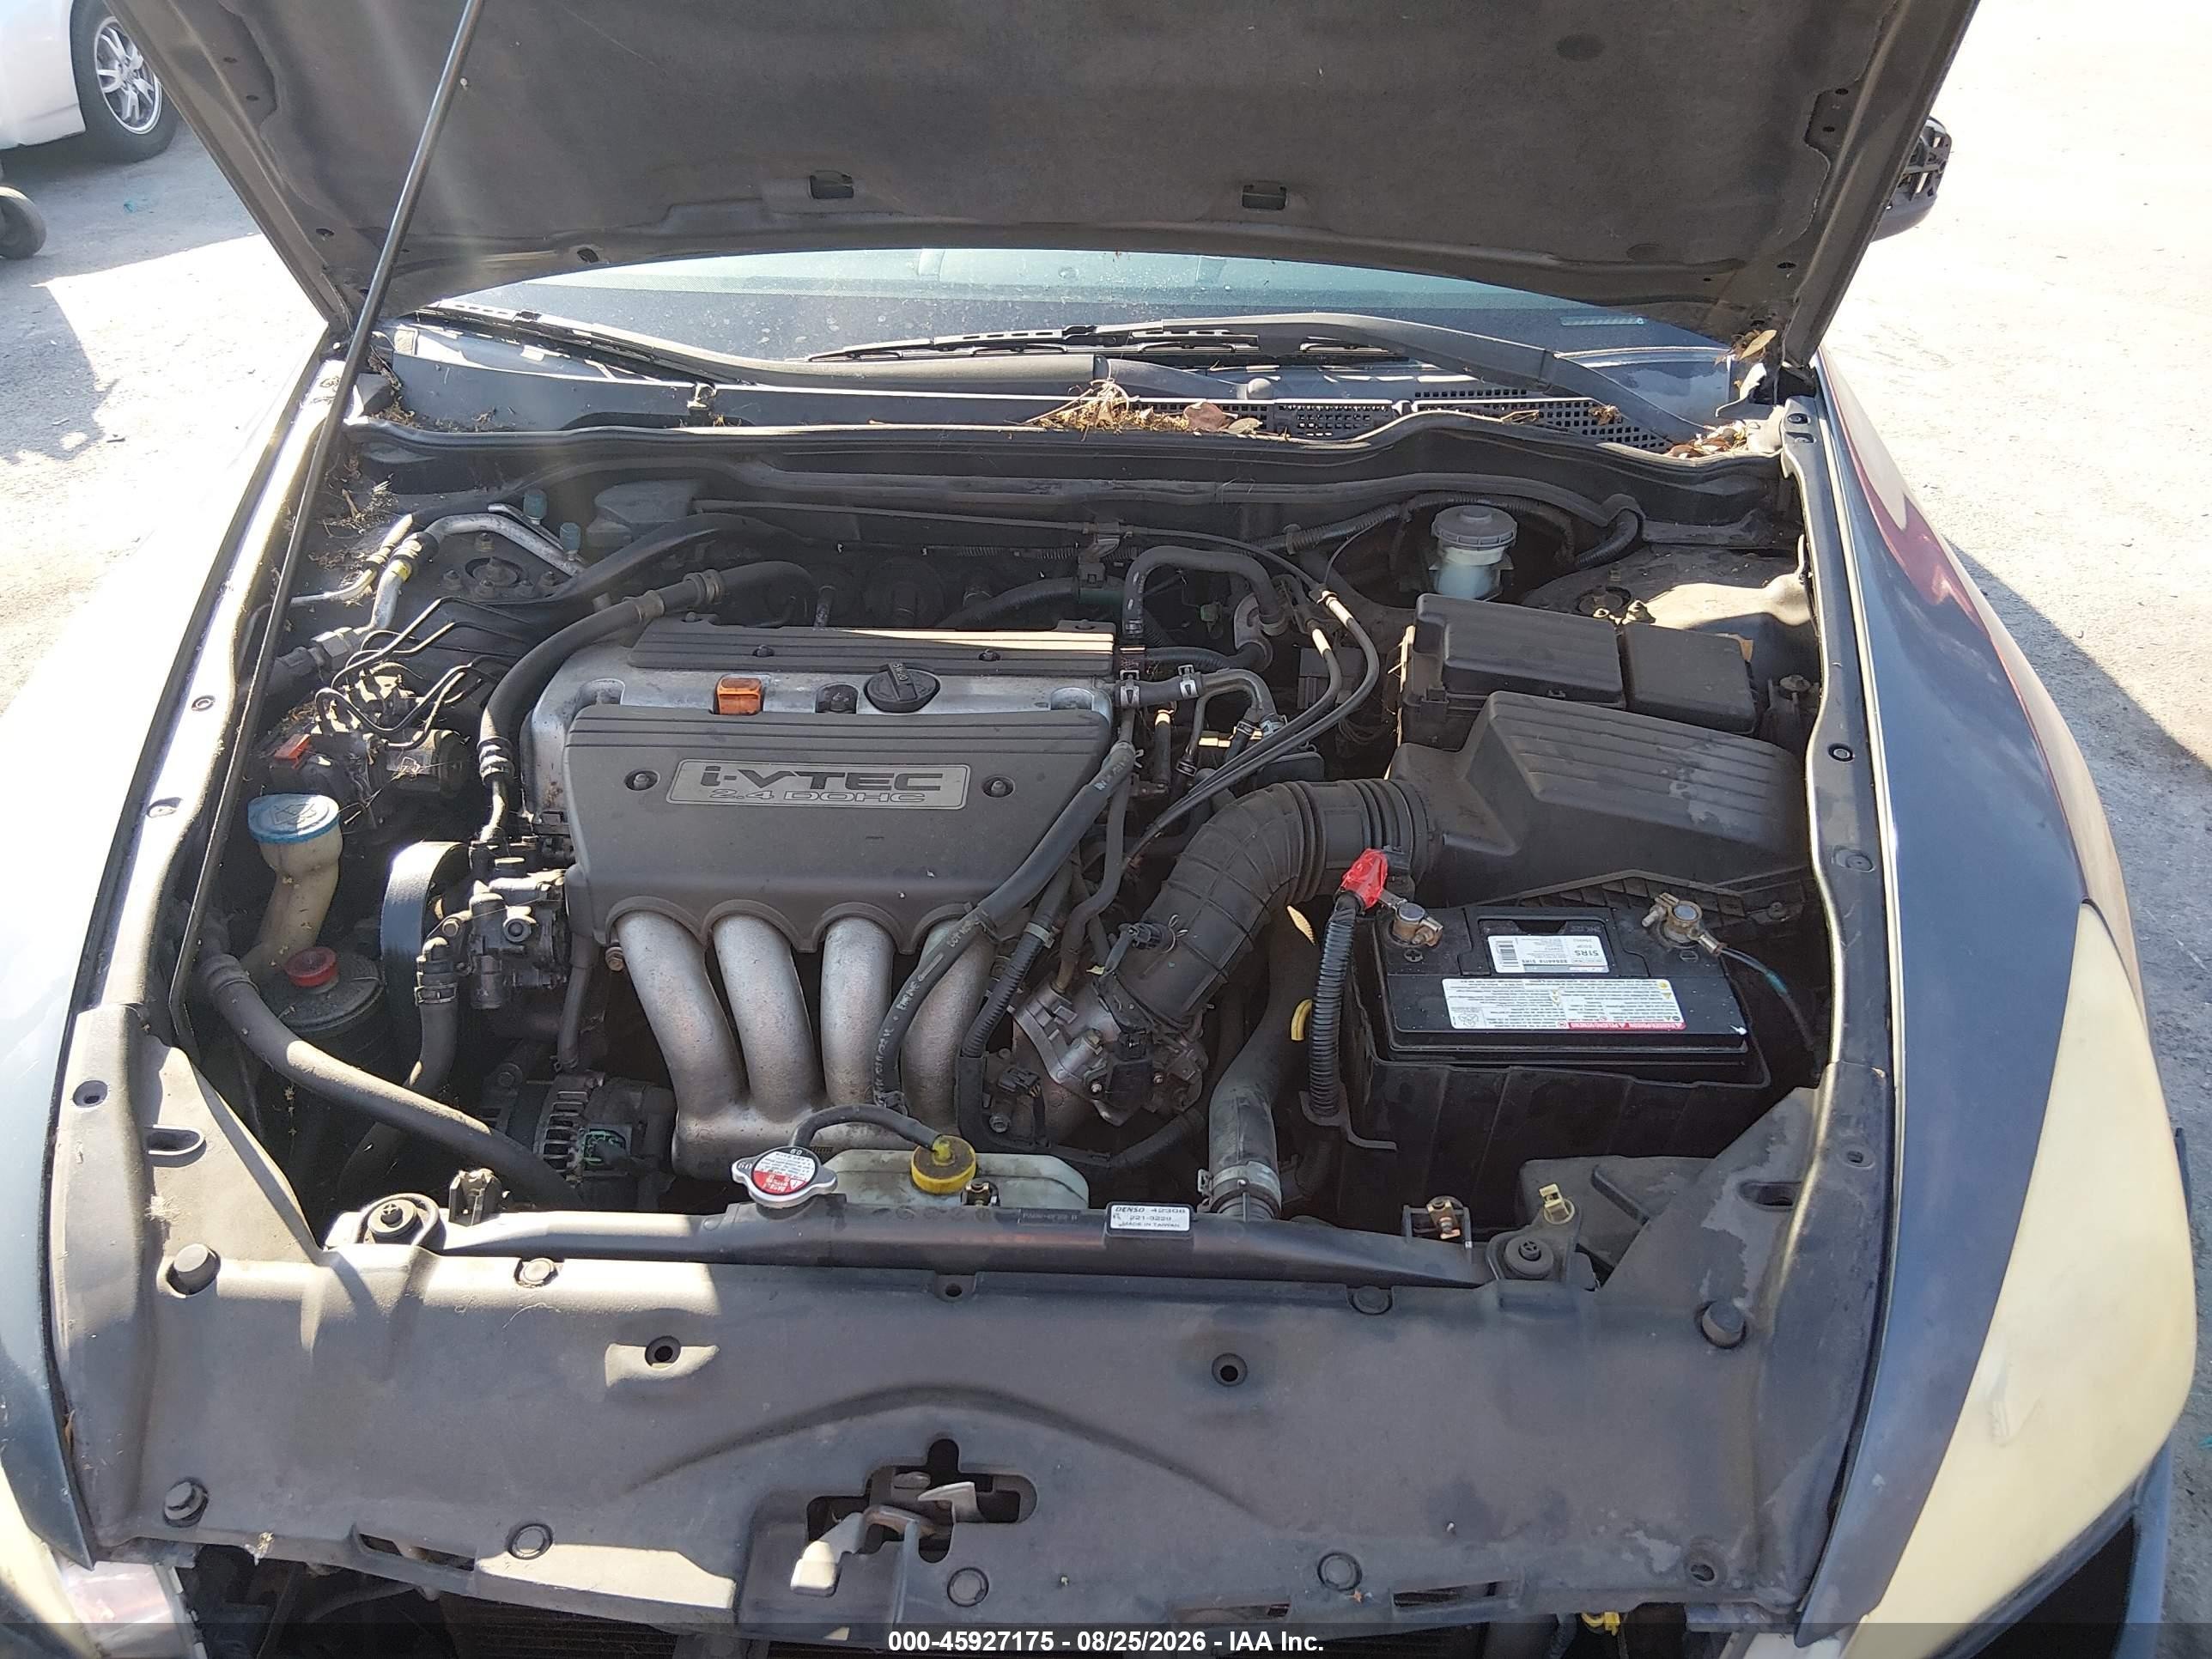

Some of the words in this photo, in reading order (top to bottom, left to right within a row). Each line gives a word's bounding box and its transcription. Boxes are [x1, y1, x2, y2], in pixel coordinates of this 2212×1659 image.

[700, 765, 944, 792] i-VTEC
[708, 788, 775, 801] 2.4
[783, 790, 926, 803] DOHC
[738, 1161, 752, 1170] 60
